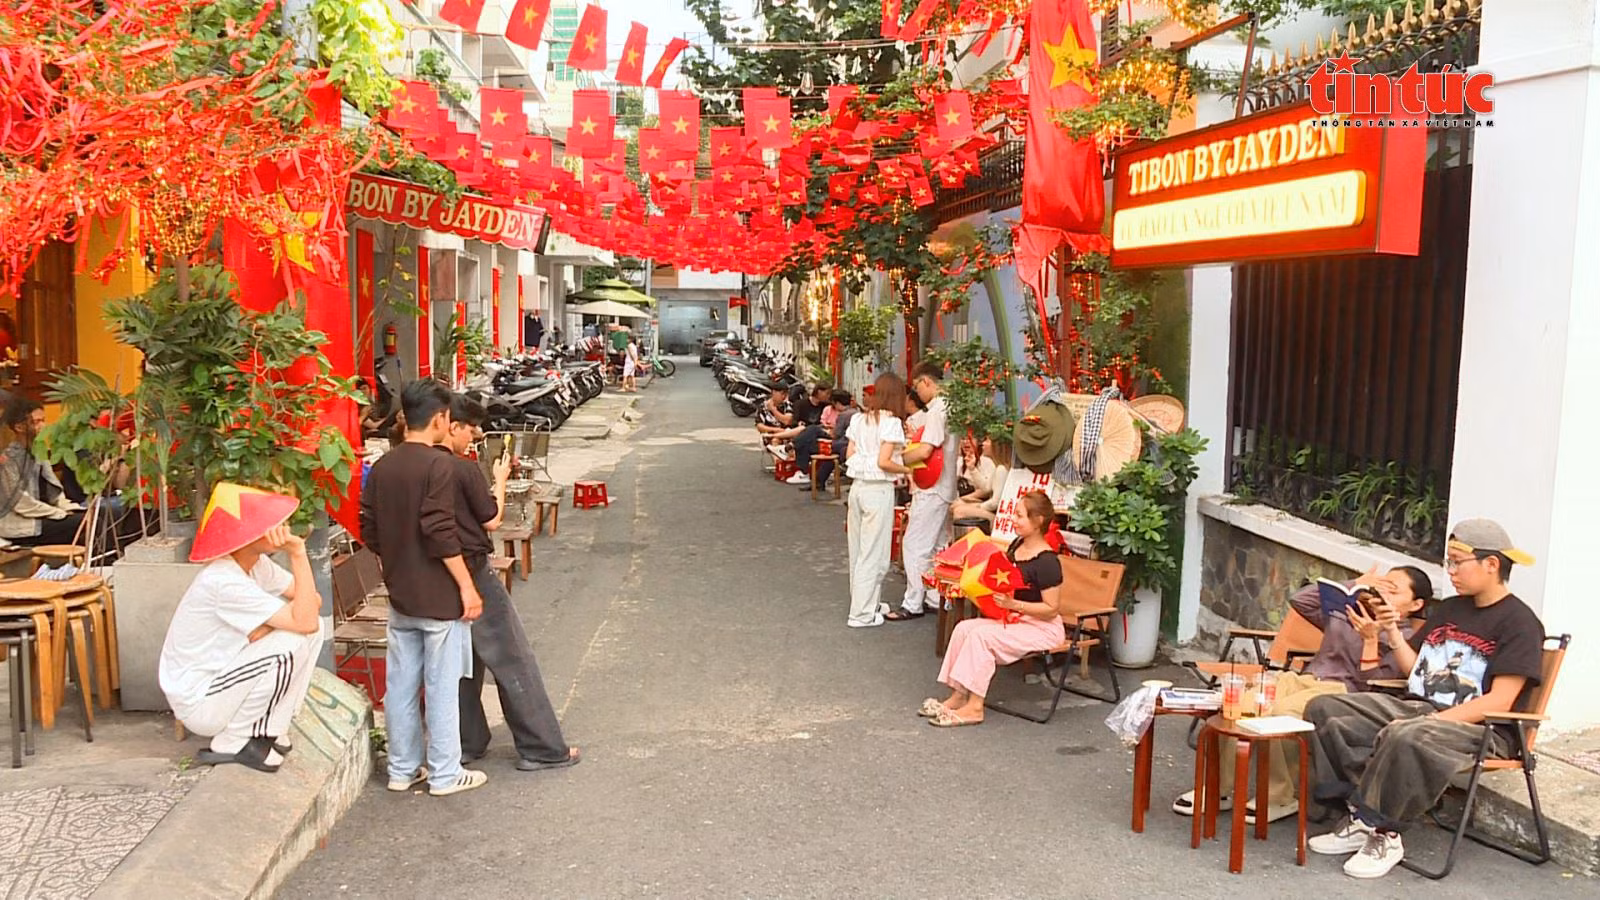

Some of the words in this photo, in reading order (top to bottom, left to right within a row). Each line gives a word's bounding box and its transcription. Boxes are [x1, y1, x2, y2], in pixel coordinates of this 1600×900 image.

[1128, 150, 1190, 196] TIBON
[1193, 140, 1228, 182] BY
[1226, 114, 1338, 176] JAYDEN
[401, 188, 438, 221] BY
[440, 200, 540, 242] JAYDEN
